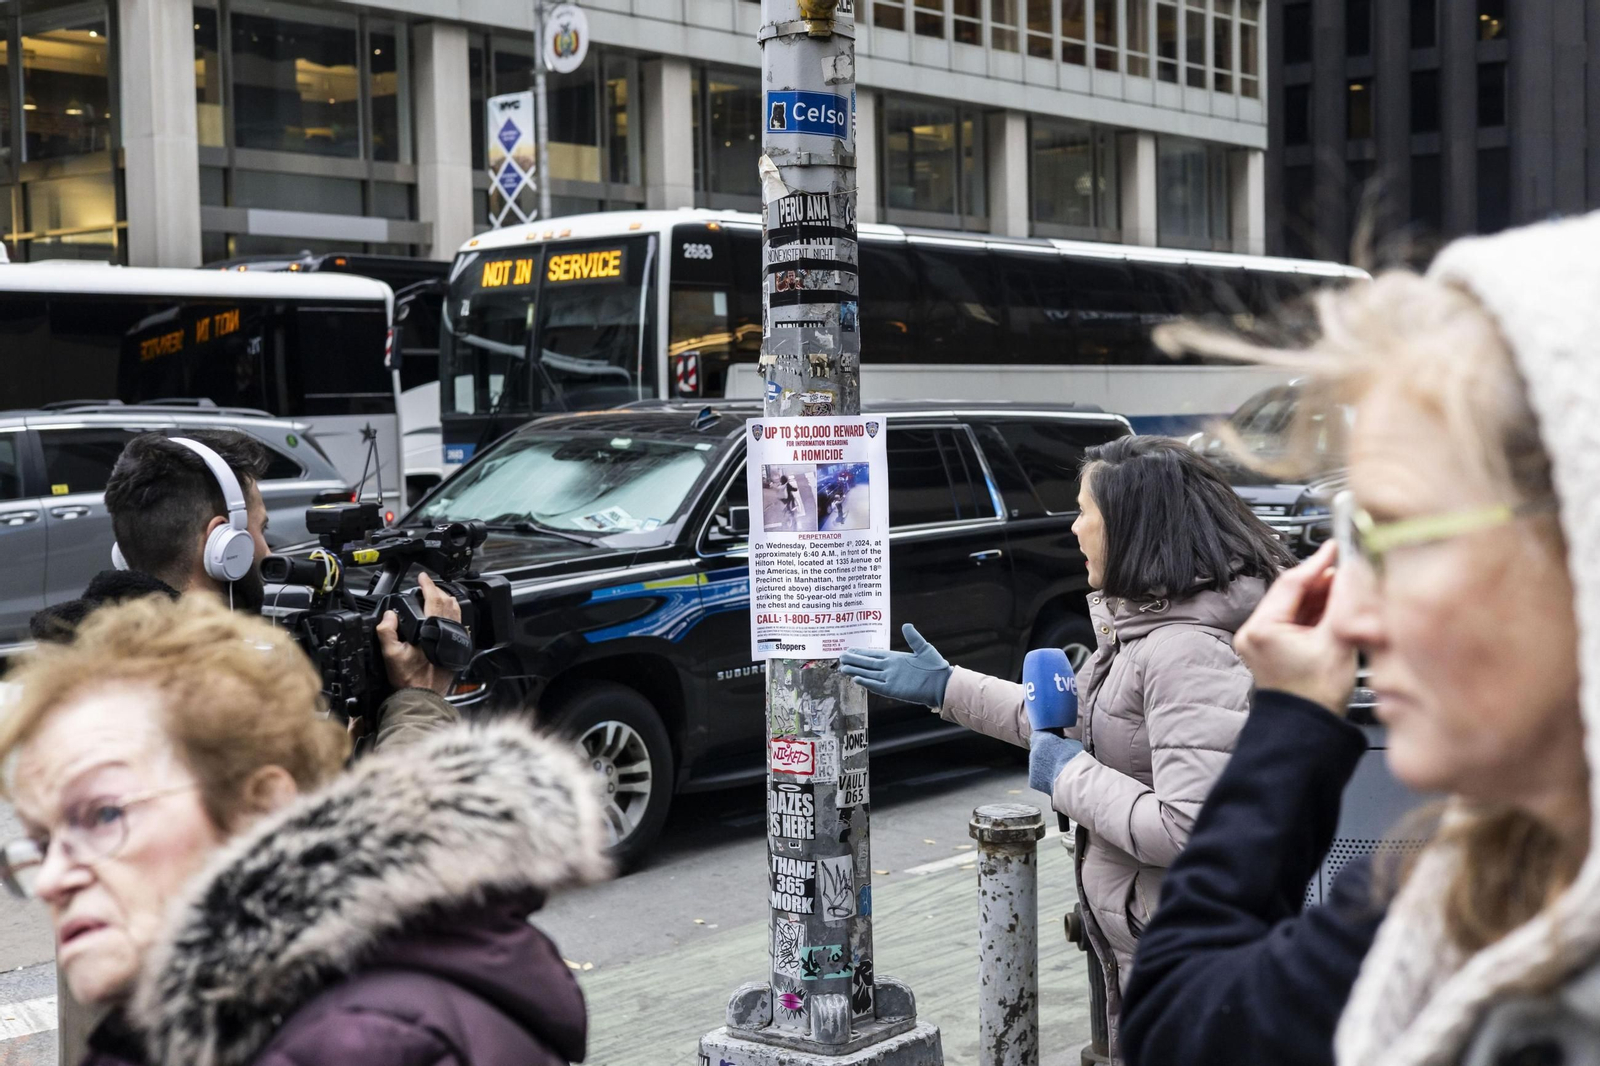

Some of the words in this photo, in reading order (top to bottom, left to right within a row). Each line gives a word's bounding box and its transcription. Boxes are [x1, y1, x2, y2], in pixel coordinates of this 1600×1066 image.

[792, 102, 844, 126] Celso
[780, 196, 804, 223] PERU
[807, 195, 829, 220] ANA
[813, 248, 834, 260] NIGHT
[482, 260, 512, 288] NOT
[513, 258, 532, 285] IN
[548, 250, 622, 282] SERVICE
[764, 426, 778, 439] UP
[780, 426, 792, 438] TO
[794, 425, 831, 440] $10,000
[834, 424, 864, 438] REWARD
[792, 451, 799, 461] A
[802, 449, 844, 461] HOMICIDE
[766, 542, 806, 550] Wednesday,
[756, 585, 786, 593] (pictured
[756, 594, 780, 602] striking
[796, 593, 836, 602] 50-year-old
[844, 600, 864, 608] demise.
[757, 614, 782, 624] CALL:
[784, 612, 853, 624] 1-800-577-8477
[856, 610, 882, 622] (TIPS)
[452, 632, 470, 647] SONY
[776, 642, 806, 651] stoppers
[1054, 672, 1077, 696] tve
[839, 772, 868, 790] VAULT
[770, 790, 814, 817] DAZES
[845, 789, 864, 804] D65
[770, 814, 780, 837] IS
[782, 815, 814, 840] HERE
[772, 854, 816, 879] THANE
[776, 874, 805, 896] 365
[772, 890, 814, 914] MORK
